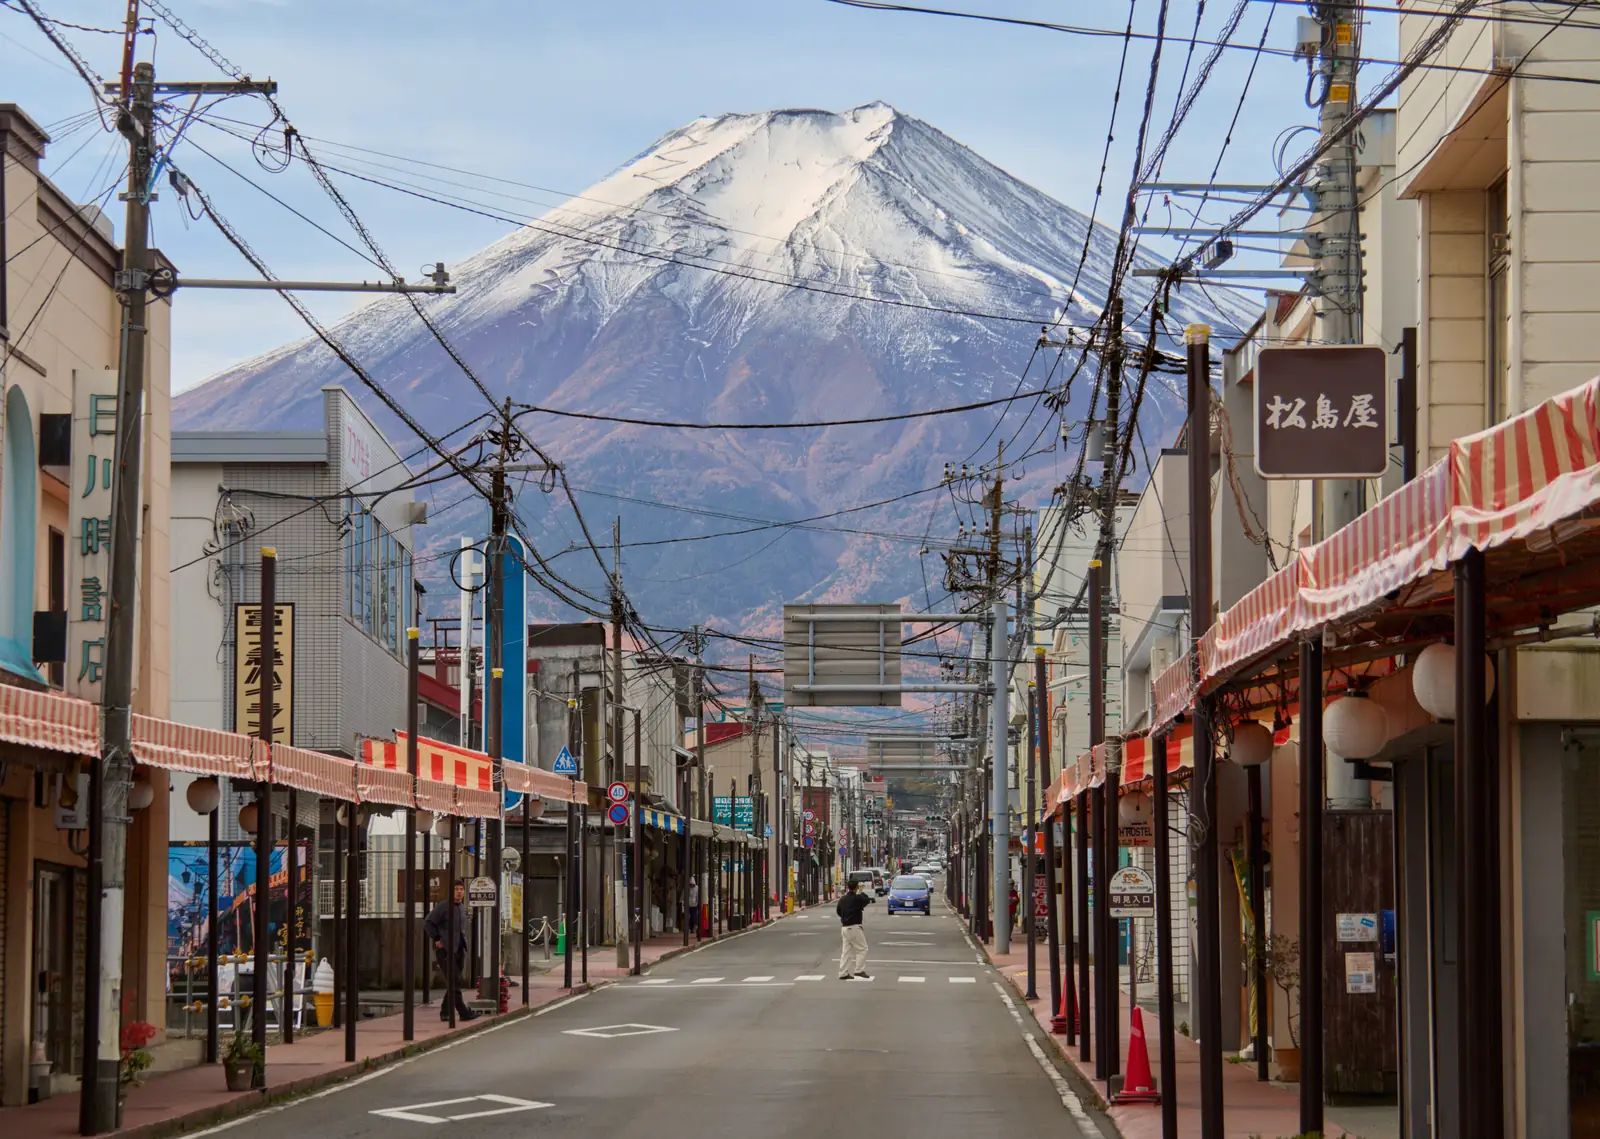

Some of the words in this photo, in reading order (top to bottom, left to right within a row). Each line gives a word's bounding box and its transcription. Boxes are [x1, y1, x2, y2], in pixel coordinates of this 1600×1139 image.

[1265, 393, 1379, 430] 松島屋
[612, 787, 624, 798] 40
[1112, 895, 1150, 903] 明見入口
